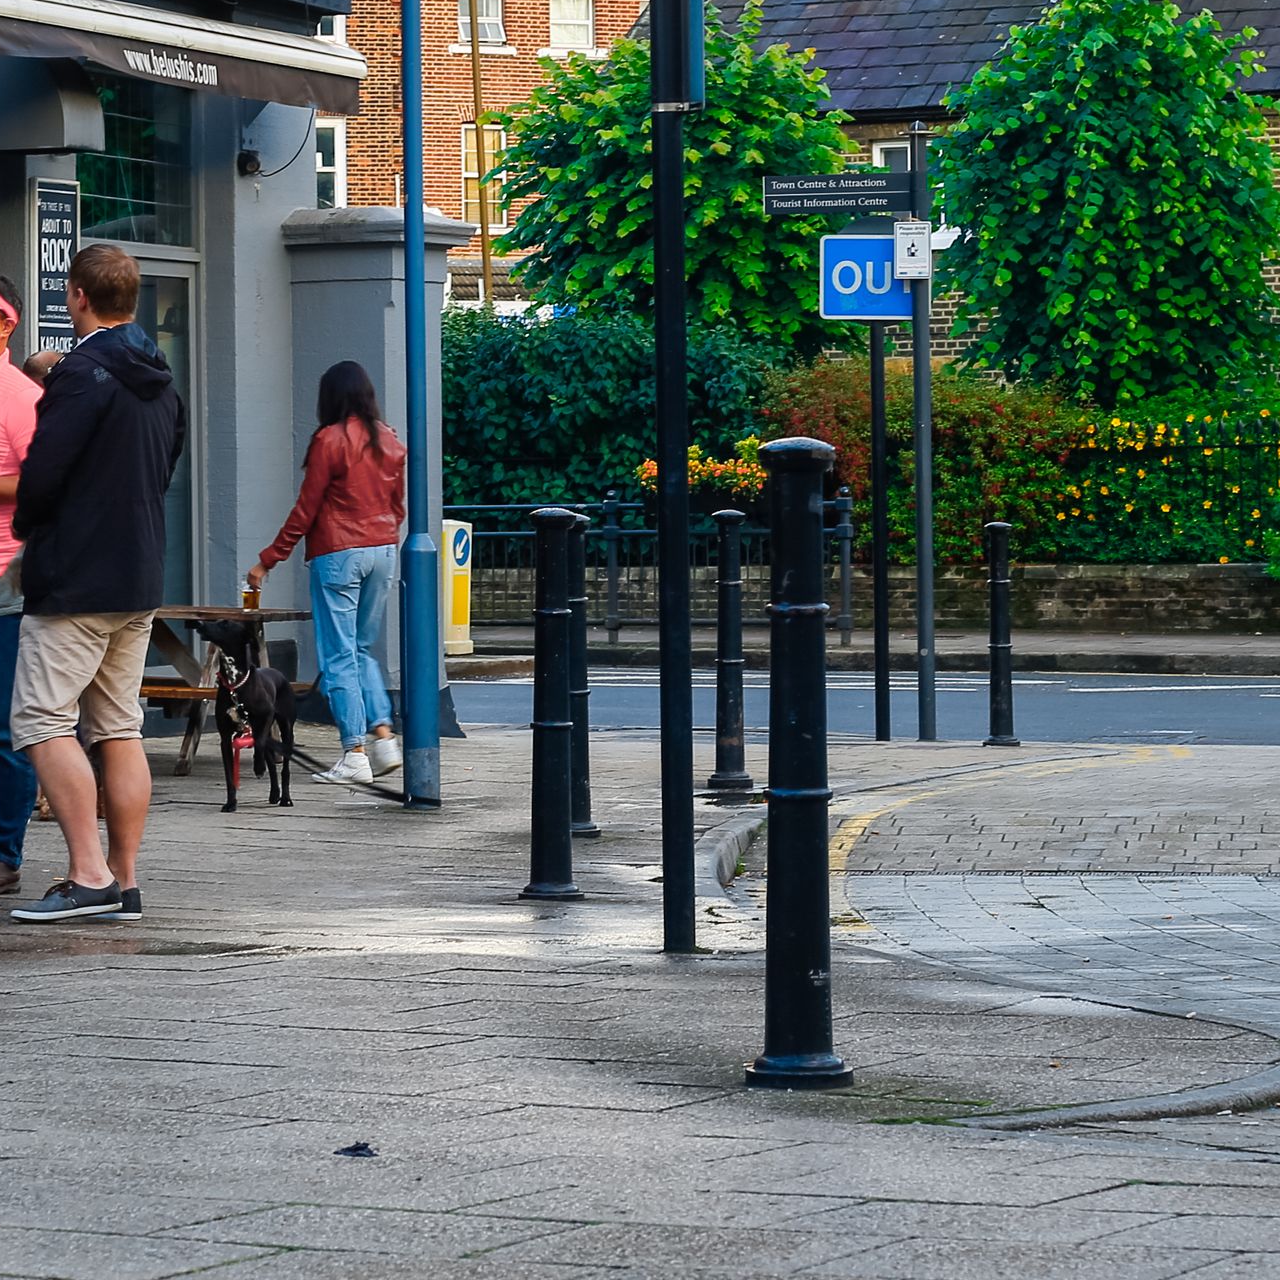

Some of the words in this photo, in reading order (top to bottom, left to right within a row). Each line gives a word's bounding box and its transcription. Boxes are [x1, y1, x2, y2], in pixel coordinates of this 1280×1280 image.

[123, 48, 218, 86] www.belushis.com
[771, 180, 795, 190] Town
[797, 180, 827, 189] Centre
[828, 179, 837, 188] &
[838, 178, 887, 188] Attractions
[771, 199, 801, 208] Tourist
[803, 197, 856, 208] Information
[858, 197, 888, 206] Centre
[41, 218, 61, 234] ABOUT
[62, 219, 72, 234] TO
[41, 238, 72, 273] ROCK
[832, 260, 911, 295] OU
[40, 335, 73, 353] KARAOKE
